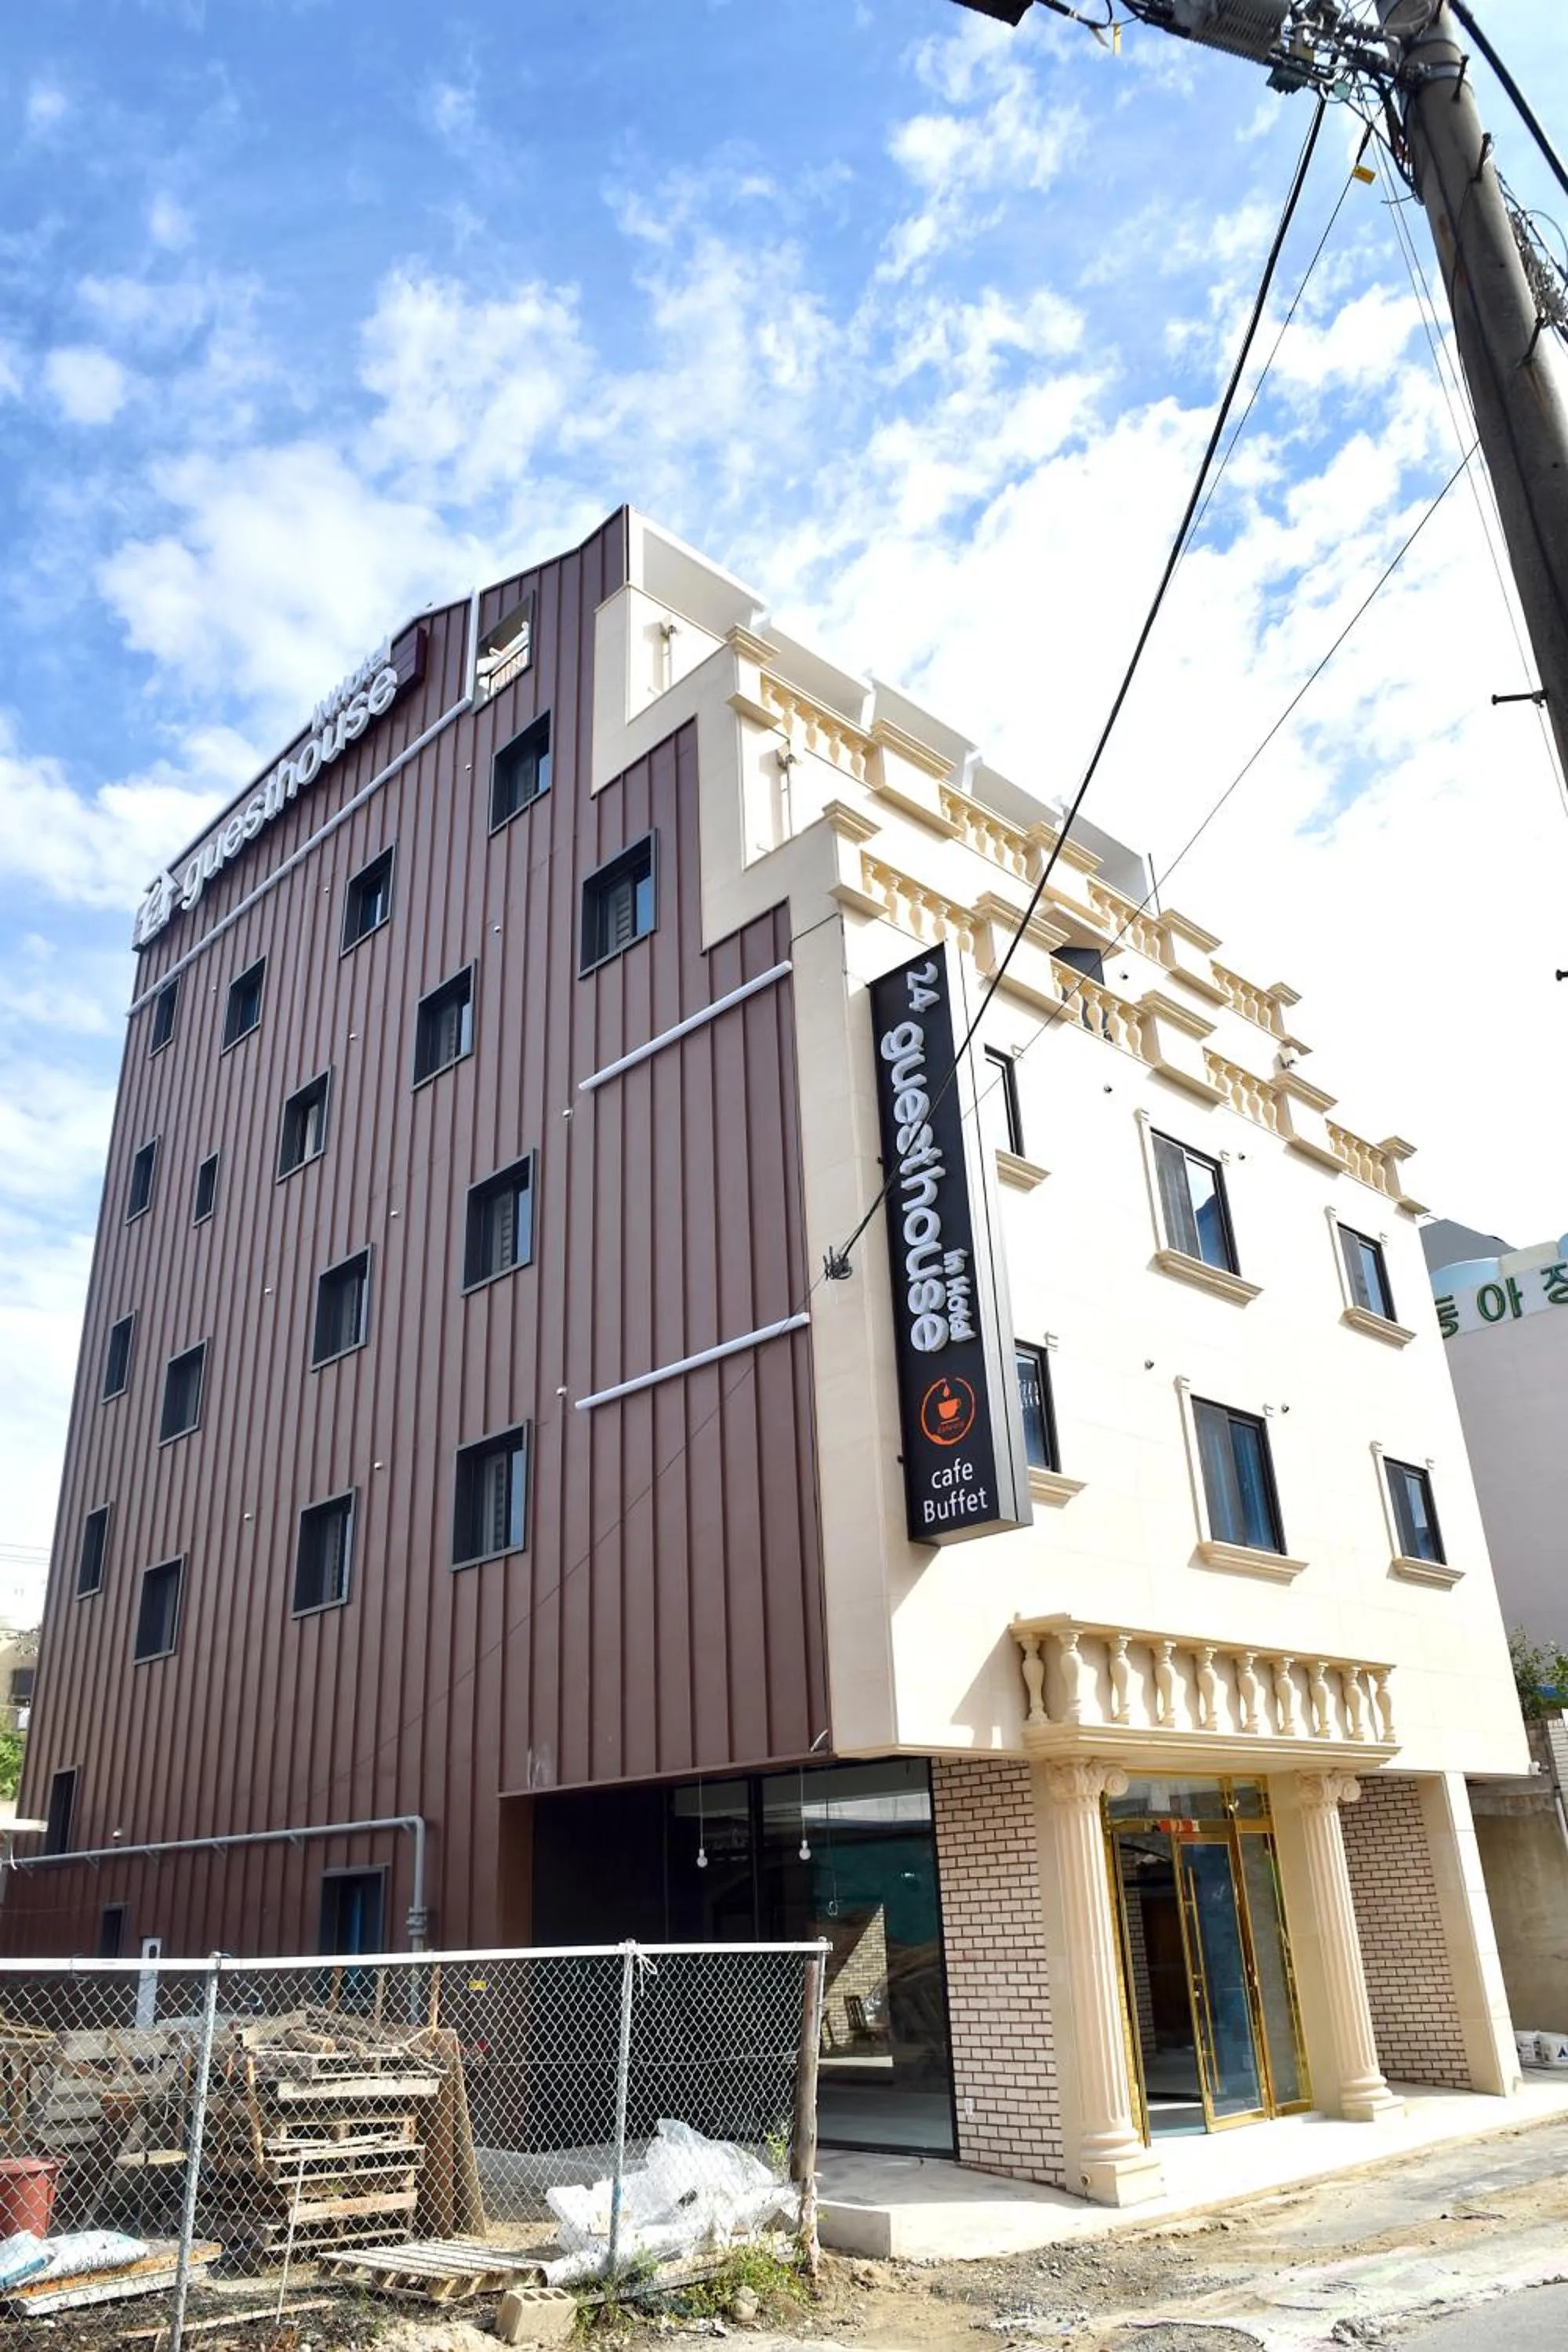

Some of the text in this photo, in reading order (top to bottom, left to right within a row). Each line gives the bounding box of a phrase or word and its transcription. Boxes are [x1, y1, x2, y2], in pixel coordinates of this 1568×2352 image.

[181, 666, 398, 912] guesthouse
[880, 961, 948, 1352] 24 guesthouse
[946, 1276, 977, 1342] Hotel
[924, 1487, 989, 1524] Buffet
[931, 1457, 974, 1490] cafe
